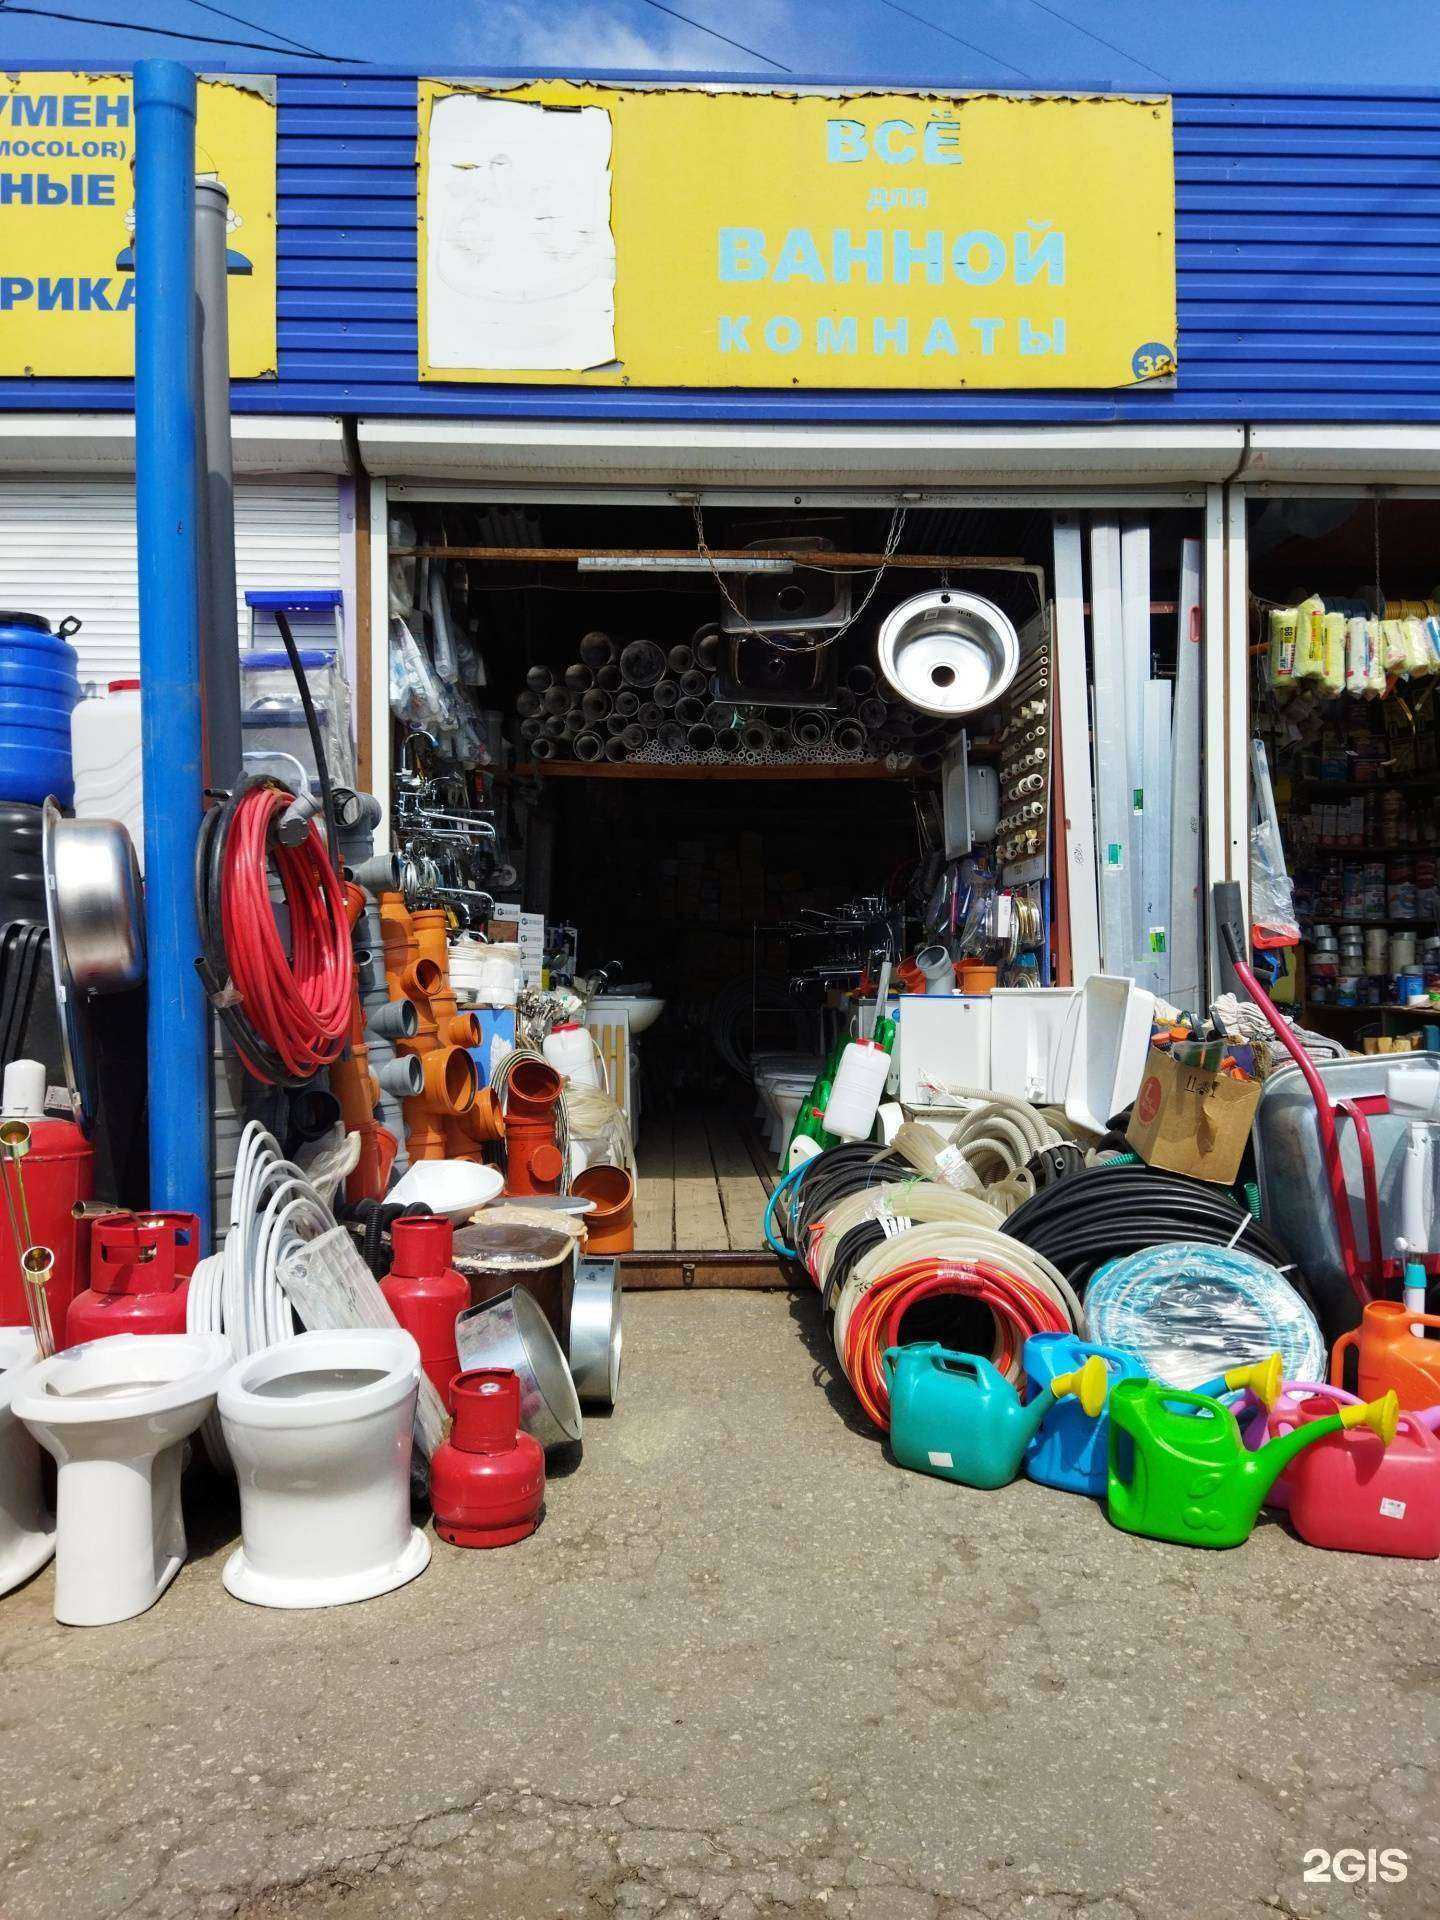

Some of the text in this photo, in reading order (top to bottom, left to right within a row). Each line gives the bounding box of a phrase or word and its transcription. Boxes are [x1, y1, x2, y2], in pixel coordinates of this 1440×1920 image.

[826, 108, 965, 165] ВСЁ
[866, 186, 930, 213] для
[718, 217, 1067, 287] ВАННОЙ
[718, 314, 1068, 357] КОМНАТЫ
